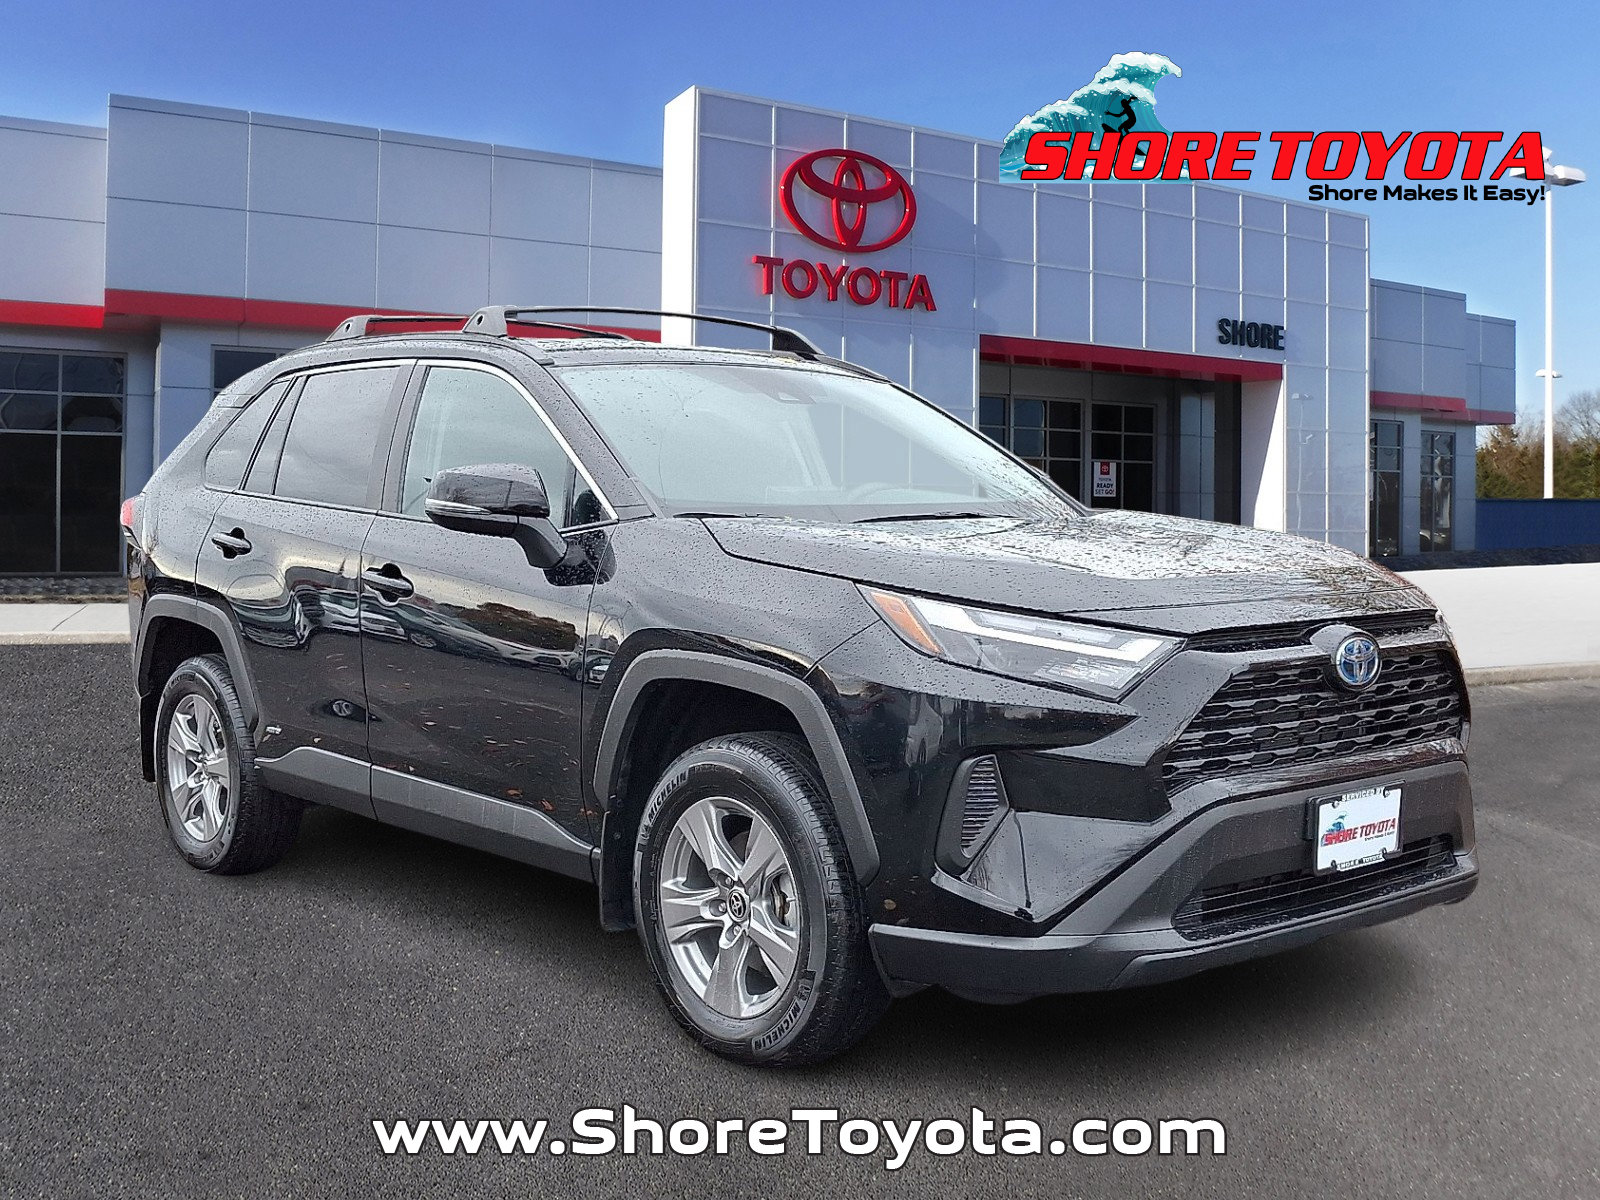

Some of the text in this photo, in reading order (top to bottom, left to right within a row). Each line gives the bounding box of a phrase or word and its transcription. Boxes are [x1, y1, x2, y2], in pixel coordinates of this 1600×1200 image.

[752, 255, 937, 311] TOYOTA
[1218, 318, 1285, 350] SHORE
[648, 770, 688, 823] MICHELIN
[1359, 817, 1396, 839] TOYOTA
[754, 1000, 802, 1051] MICHELIN
